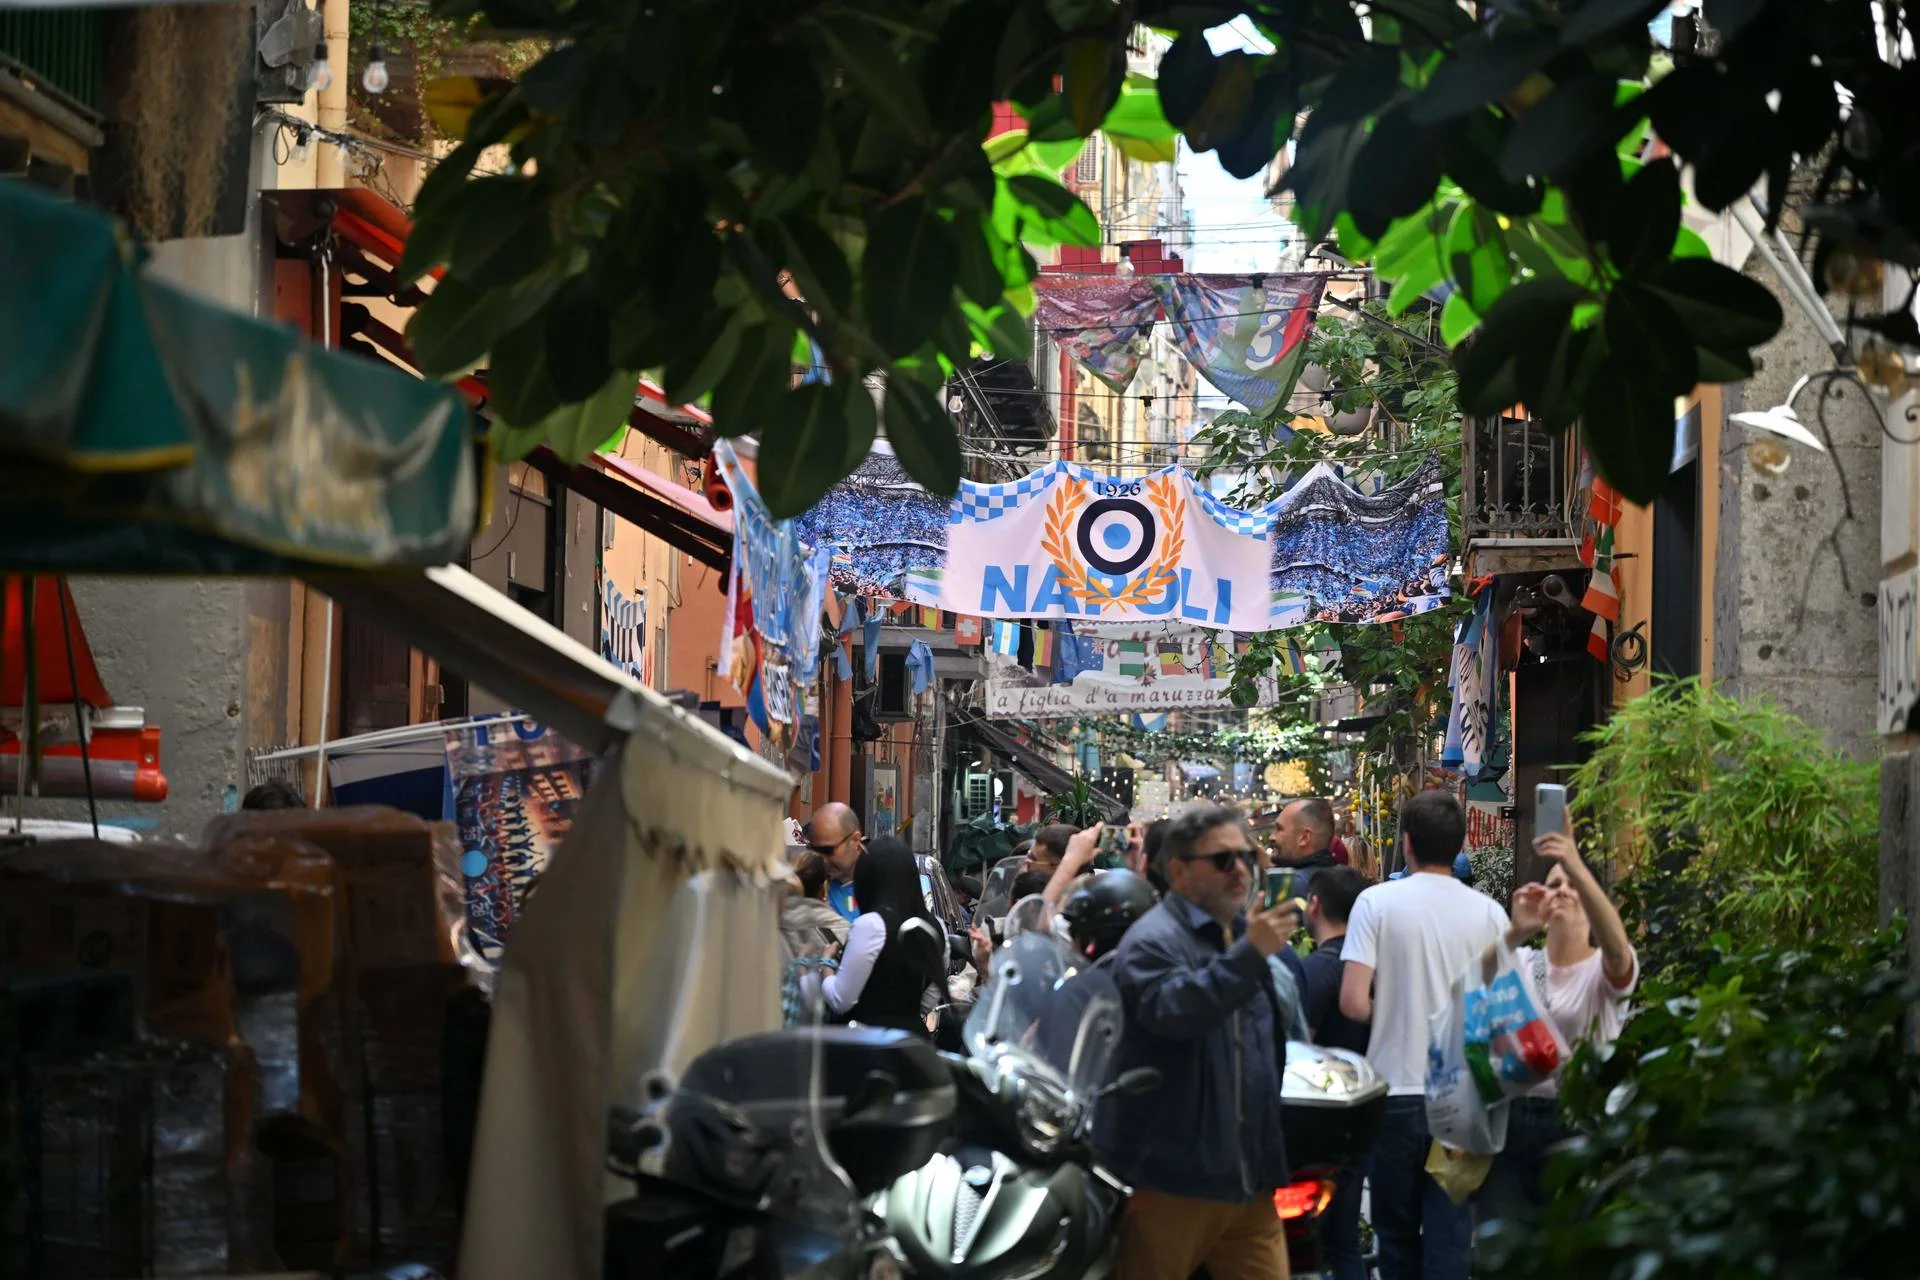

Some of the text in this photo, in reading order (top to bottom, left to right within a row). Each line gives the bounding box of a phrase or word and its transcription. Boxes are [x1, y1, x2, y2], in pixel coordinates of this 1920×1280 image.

[1246, 310, 1290, 363] 3
[1096, 481, 1141, 497] 1926
[980, 563, 1232, 625] NAPOLI
[1019, 687, 1071, 712] figlia
